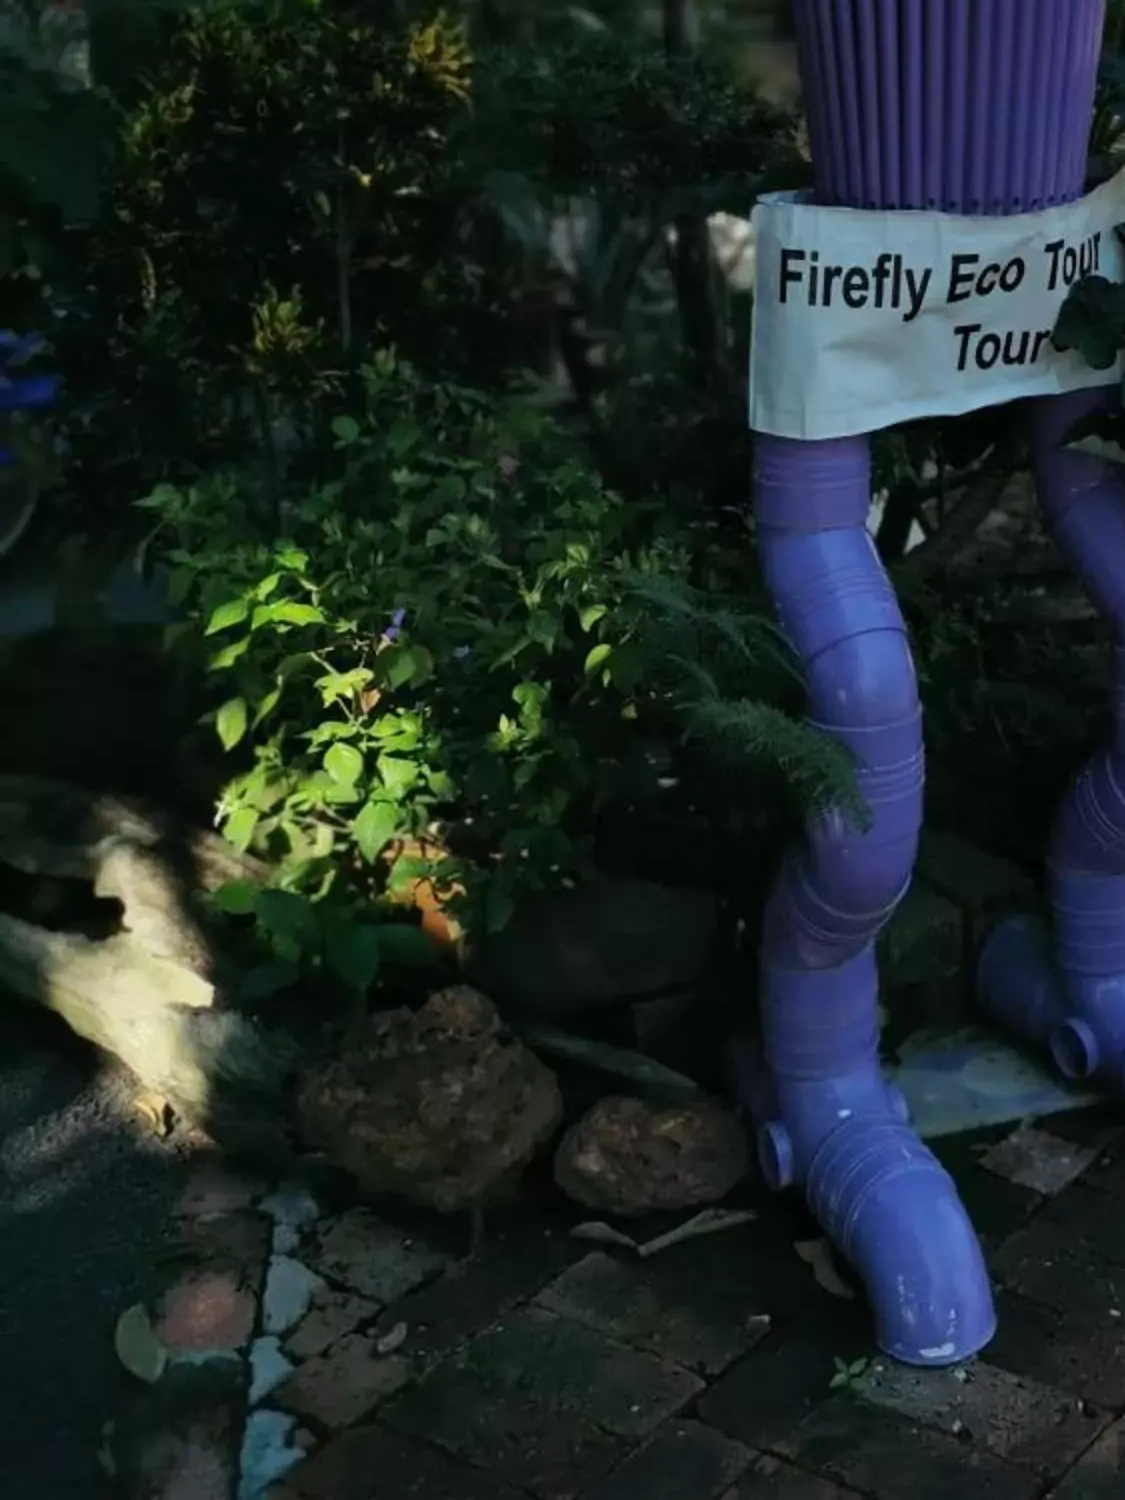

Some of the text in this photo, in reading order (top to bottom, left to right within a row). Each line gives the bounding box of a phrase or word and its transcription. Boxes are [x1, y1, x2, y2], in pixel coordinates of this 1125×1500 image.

[779, 231, 1101, 322] Firefly Eco Tour
